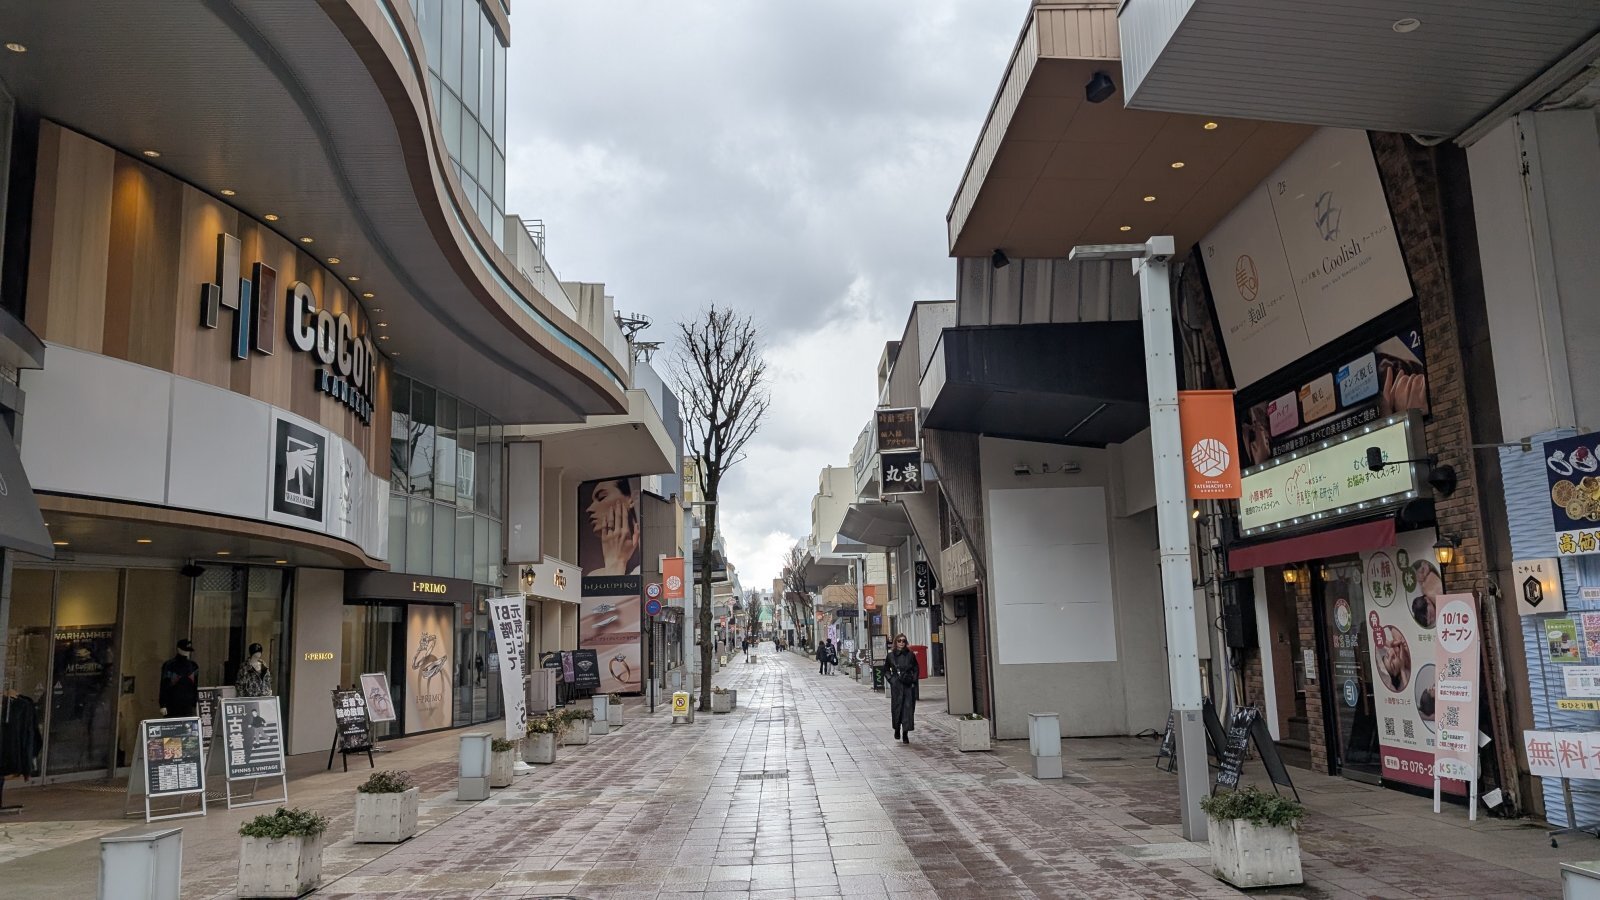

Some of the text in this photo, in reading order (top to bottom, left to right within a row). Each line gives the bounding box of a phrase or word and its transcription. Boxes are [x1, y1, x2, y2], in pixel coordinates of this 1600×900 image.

[1322, 238, 1362, 275] Coolish
[1248, 302, 1267, 327] 美all
[1343, 361, 1373, 392] メンズ脱毛
[886, 462, 918, 482] 丸貴
[286, 492, 315, 507] WARHAMMER
[1249, 487, 1273, 504] 小顔専門店
[1559, 531, 1600, 554] 高価
[1371, 560, 1391, 577] 小顔
[413, 582, 446, 594] I-PRIMO
[1373, 580, 1393, 599] 整体
[1443, 612, 1460, 624] 10/1
[1442, 627, 1472, 641] オープン
[304, 651, 334, 661] I-PRIMO
[226, 705, 243, 715] B1F
[227, 717, 247, 766] 古着屋
[255, 764, 279, 772] VINTAGE
